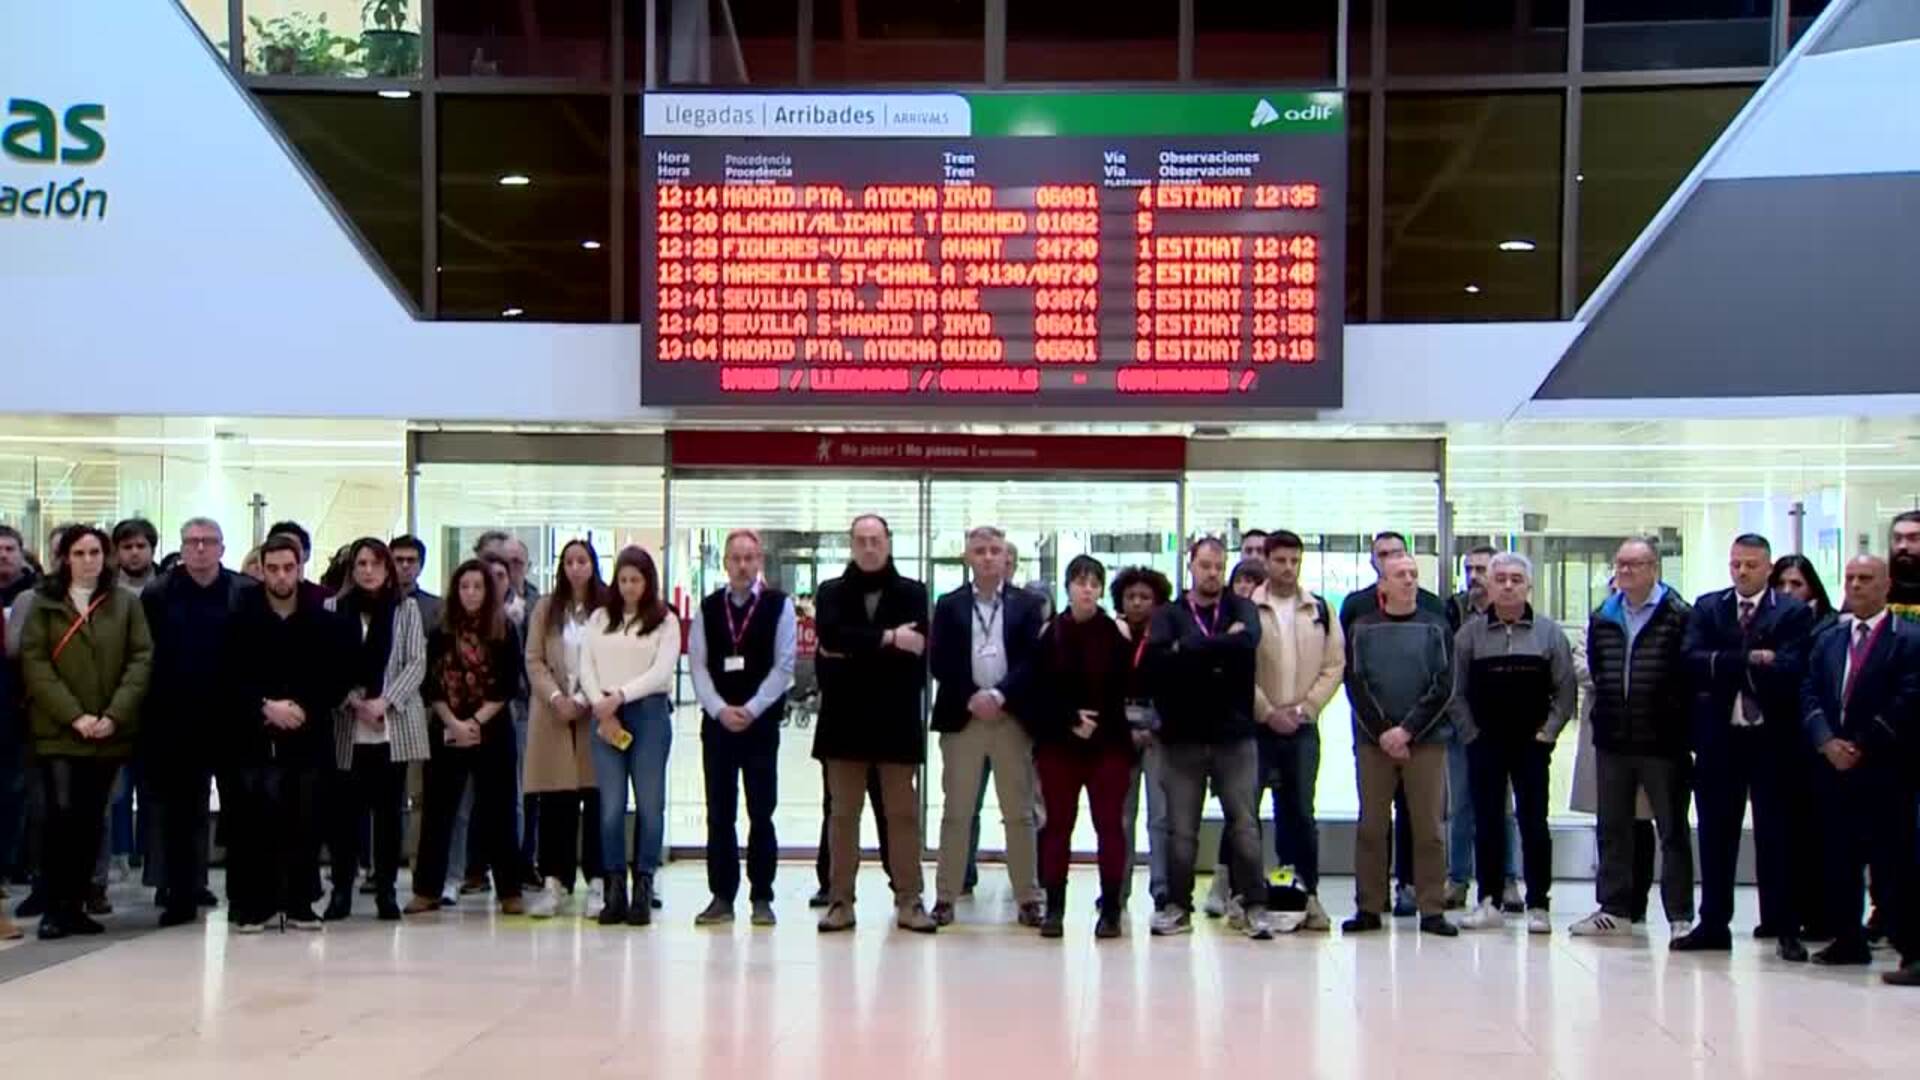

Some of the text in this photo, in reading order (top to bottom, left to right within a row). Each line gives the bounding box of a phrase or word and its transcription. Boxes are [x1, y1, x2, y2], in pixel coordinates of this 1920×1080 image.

[665, 103, 949, 127] Llegadas Arribades ARRIVALS
[1284, 106, 1333, 121] adif
[657, 152, 690, 164] Hora
[725, 154, 792, 166] Procedencia
[943, 152, 975, 164] Tren
[1159, 152, 1260, 164] Observaciones
[657, 166, 690, 177] Hora
[943, 165, 975, 177] Tren
[1159, 166, 1251, 177] Observacions
[659, 186, 717, 207] 12:14
[723, 186, 796, 207] MADRID
[805, 187, 853, 207] PTA.
[864, 187, 937, 208] ATOCHA
[1138, 186, 1151, 207] 4
[1157, 186, 1243, 207] ESTIMAT
[1254, 186, 1316, 207] 12:35
[659, 212, 718, 233] 12:20
[723, 212, 913, 233] ALACANT/ALICANTE
[1036, 212, 1097, 233] 01092
[1138, 212, 1152, 232] 5
[659, 237, 718, 258] 12:29
[941, 238, 1002, 259] AVANT
[1036, 238, 1098, 259] 34730
[1140, 238, 1151, 258] 1
[1157, 237, 1242, 258] ESTIMAT
[1254, 237, 1314, 258] 12:42
[941, 264, 955, 284] A
[1137, 264, 1152, 284] 2
[1156, 263, 1242, 284] ESTIMAT
[659, 288, 718, 309] 12:41
[723, 288, 807, 309] SEVILLA
[817, 289, 864, 309] STA.
[876, 289, 937, 310] JUSTA
[941, 289, 978, 310] AVE
[1156, 288, 1241, 310] ESTIMAT
[1254, 288, 1314, 309] 12:59
[659, 314, 718, 334] 12:49
[723, 314, 807, 335] SEVILLA
[817, 314, 913, 335] S-MADRID
[923, 314, 937, 335] P
[1137, 314, 1151, 335] 3
[1156, 314, 1241, 335] ESTIMAT
[659, 339, 717, 360] 13:04
[723, 339, 796, 360] MADRID
[805, 339, 853, 360] PTA.
[864, 339, 936, 360] ATOCHA
[1156, 340, 1240, 360] ESTIMAT
[1253, 340, 1314, 360] 13:19
